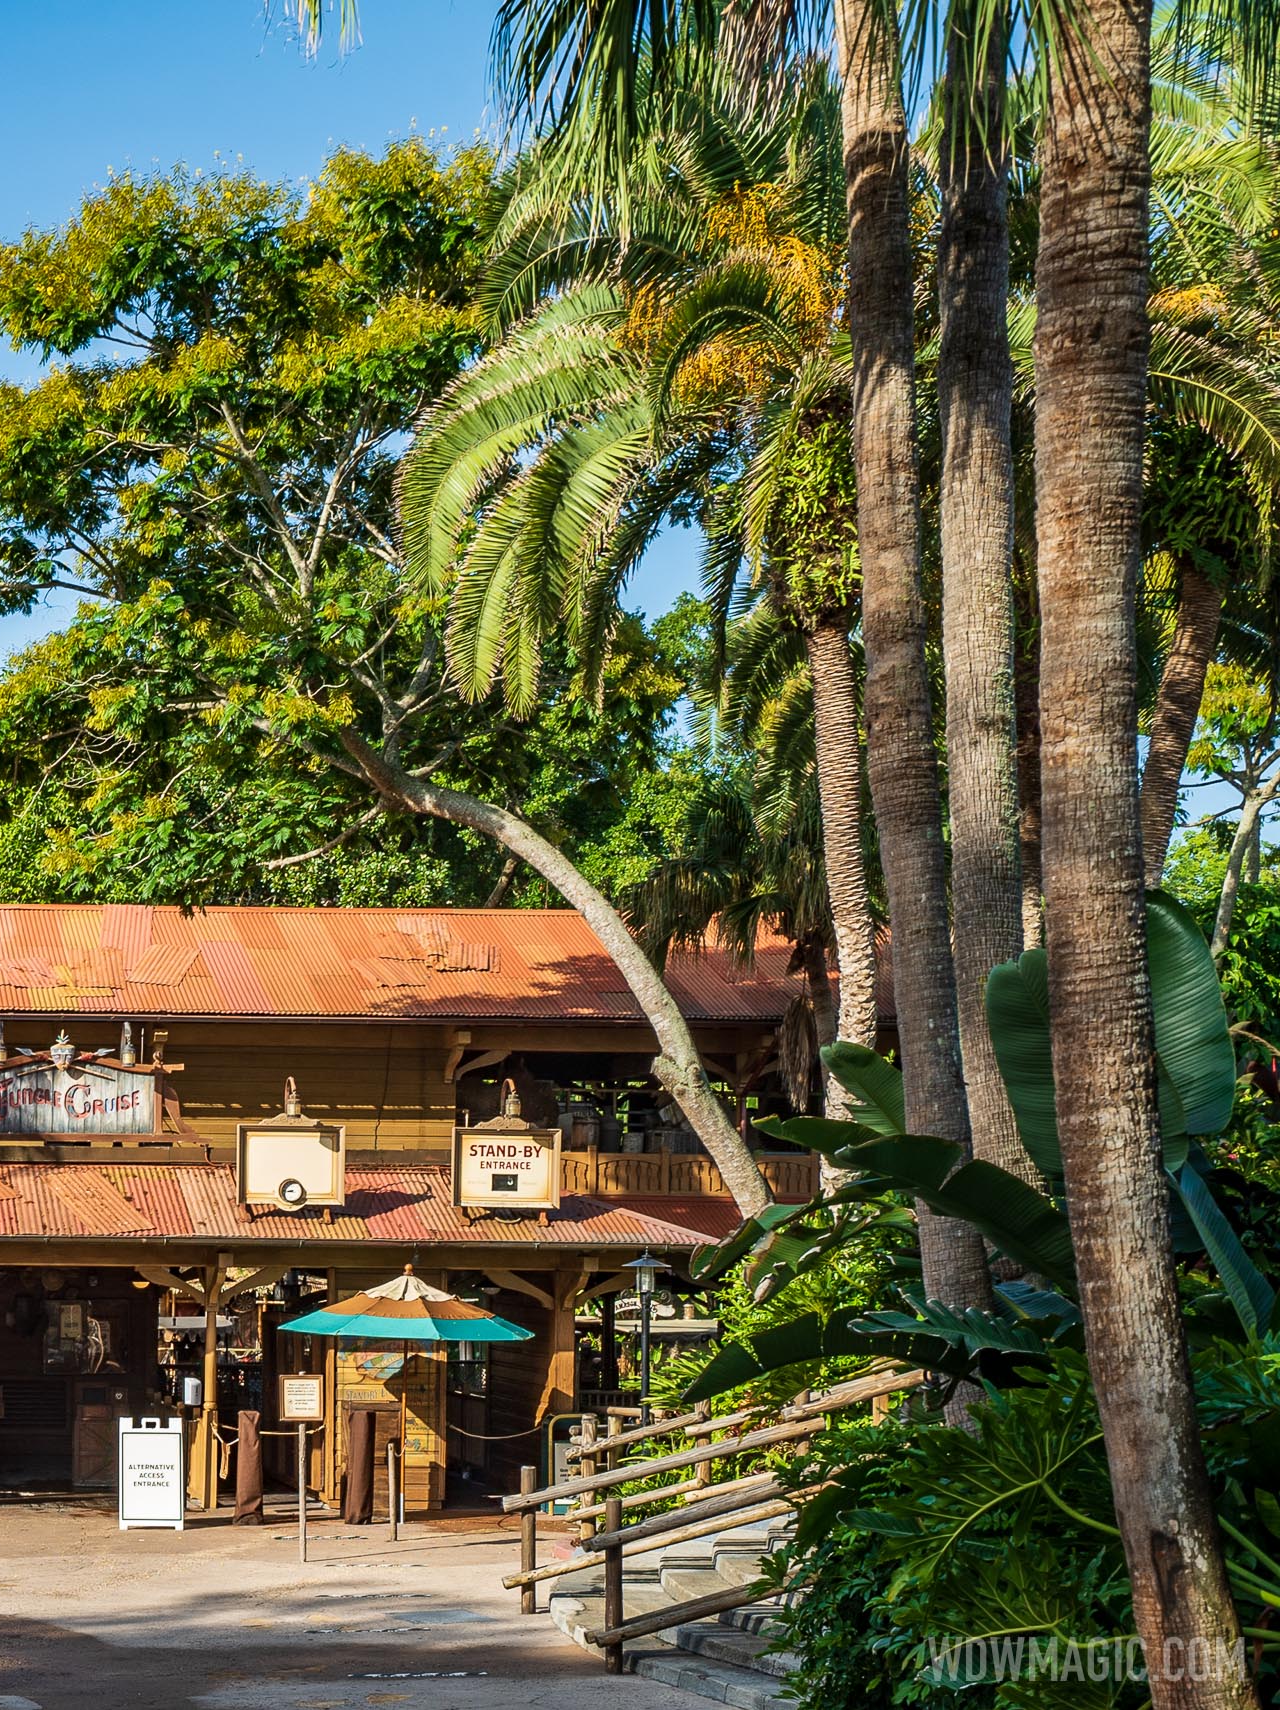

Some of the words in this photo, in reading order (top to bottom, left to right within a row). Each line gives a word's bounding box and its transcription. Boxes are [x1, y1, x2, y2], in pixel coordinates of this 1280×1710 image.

[64, 1083, 140, 1120] CRUISE
[469, 1144, 542, 1158] STAND-BY
[480, 1161, 531, 1170] ENTRANCE
